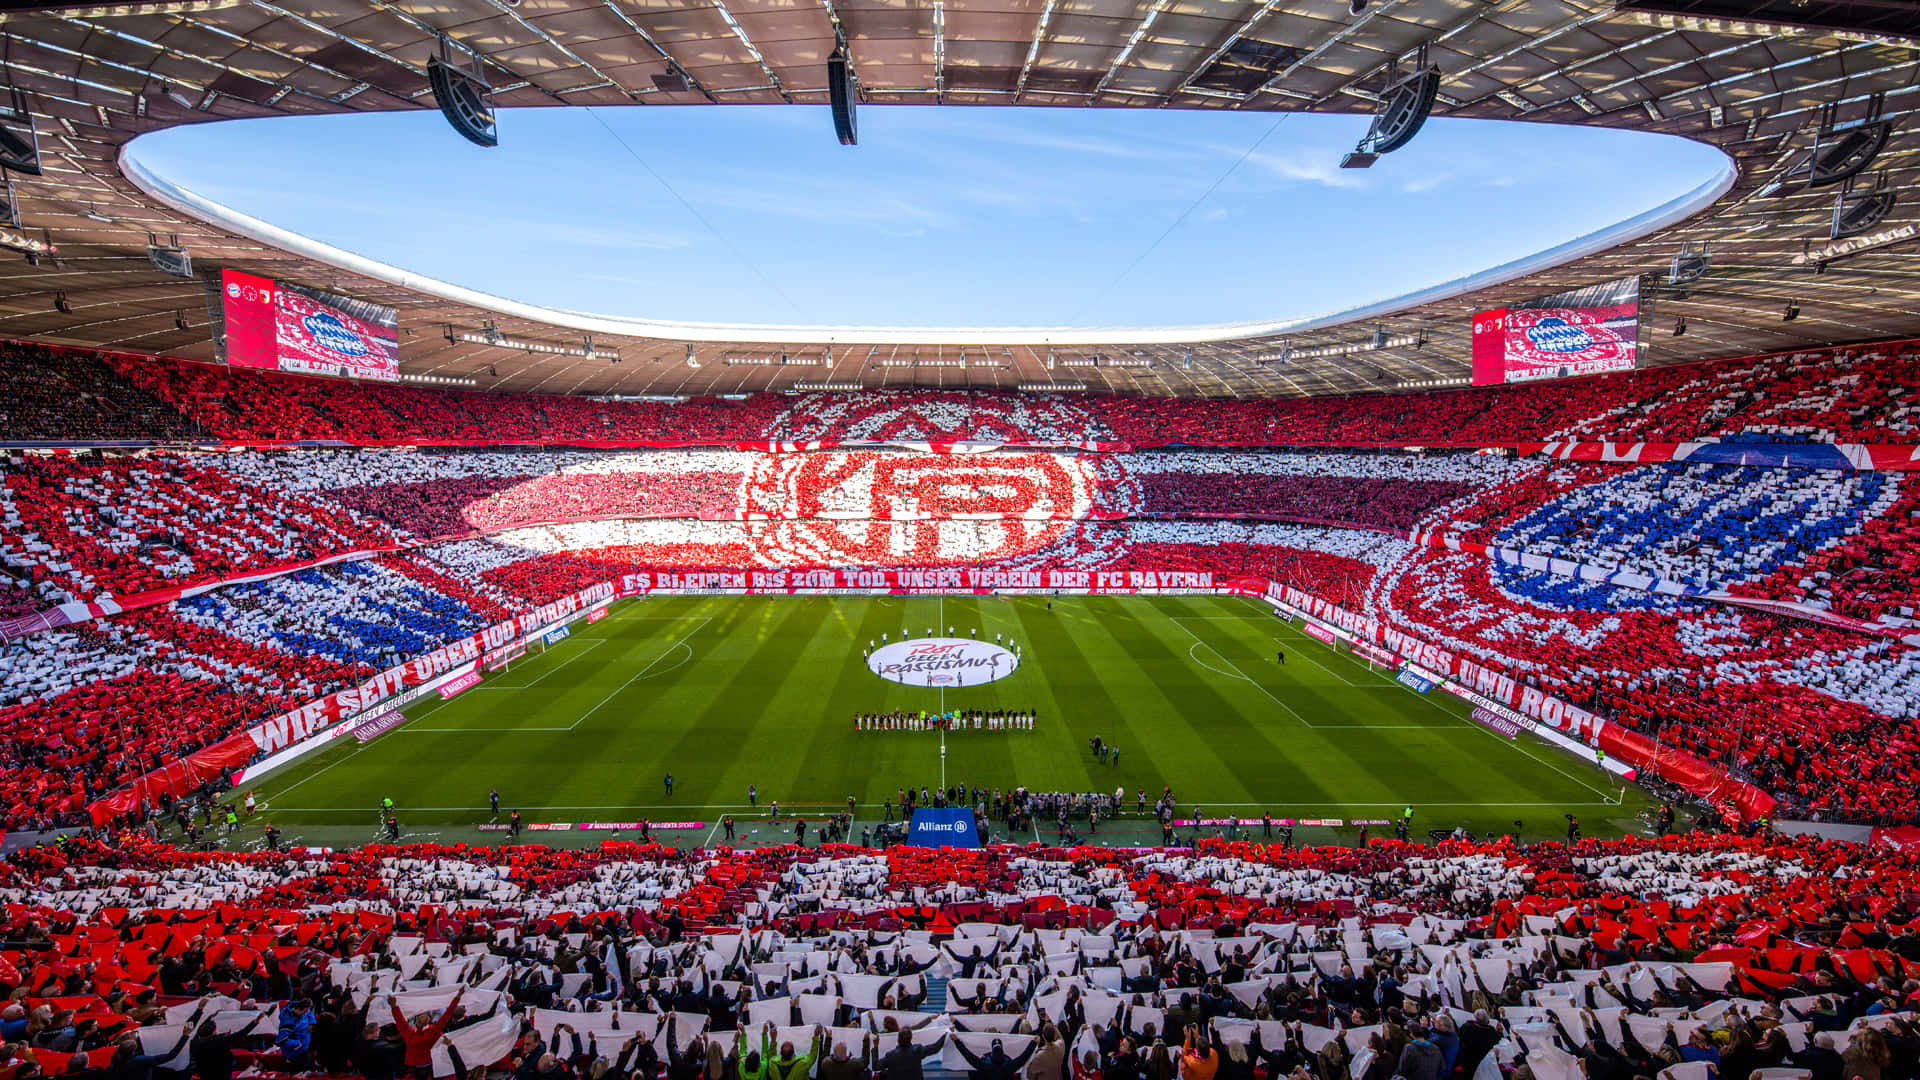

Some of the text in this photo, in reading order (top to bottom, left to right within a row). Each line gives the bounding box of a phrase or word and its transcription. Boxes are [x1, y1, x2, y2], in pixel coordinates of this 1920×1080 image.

[623, 573, 651, 588] ES
[752, 572, 786, 588] BIS
[843, 571, 890, 588] TOD.
[898, 571, 961, 588] UNSER
[967, 571, 1041, 588] VEREIN
[1049, 571, 1090, 588] DER
[1097, 571, 1124, 588] FC
[1130, 571, 1213, 588] BAYERN
[904, 648, 964, 663] GEGEN
[910, 642, 970, 655] ROT
[247, 699, 328, 754] WIE
[336, 664, 410, 720] SEIT
[481, 619, 515, 652] 100
[519, 599, 576, 633] JAHREN
[578, 580, 614, 606] WIRD
[881, 652, 1006, 674] RASSISMUS
[1268, 580, 1283, 600] IN
[1287, 586, 1313, 613] DEN
[1314, 598, 1378, 643] FARBEN
[1385, 625, 1452, 675] WEISS
[1460, 659, 1515, 706] UND
[1520, 685, 1606, 747] ROT!
[353, 720, 379, 740] QATAR
[918, 821, 953, 831] Allianz
